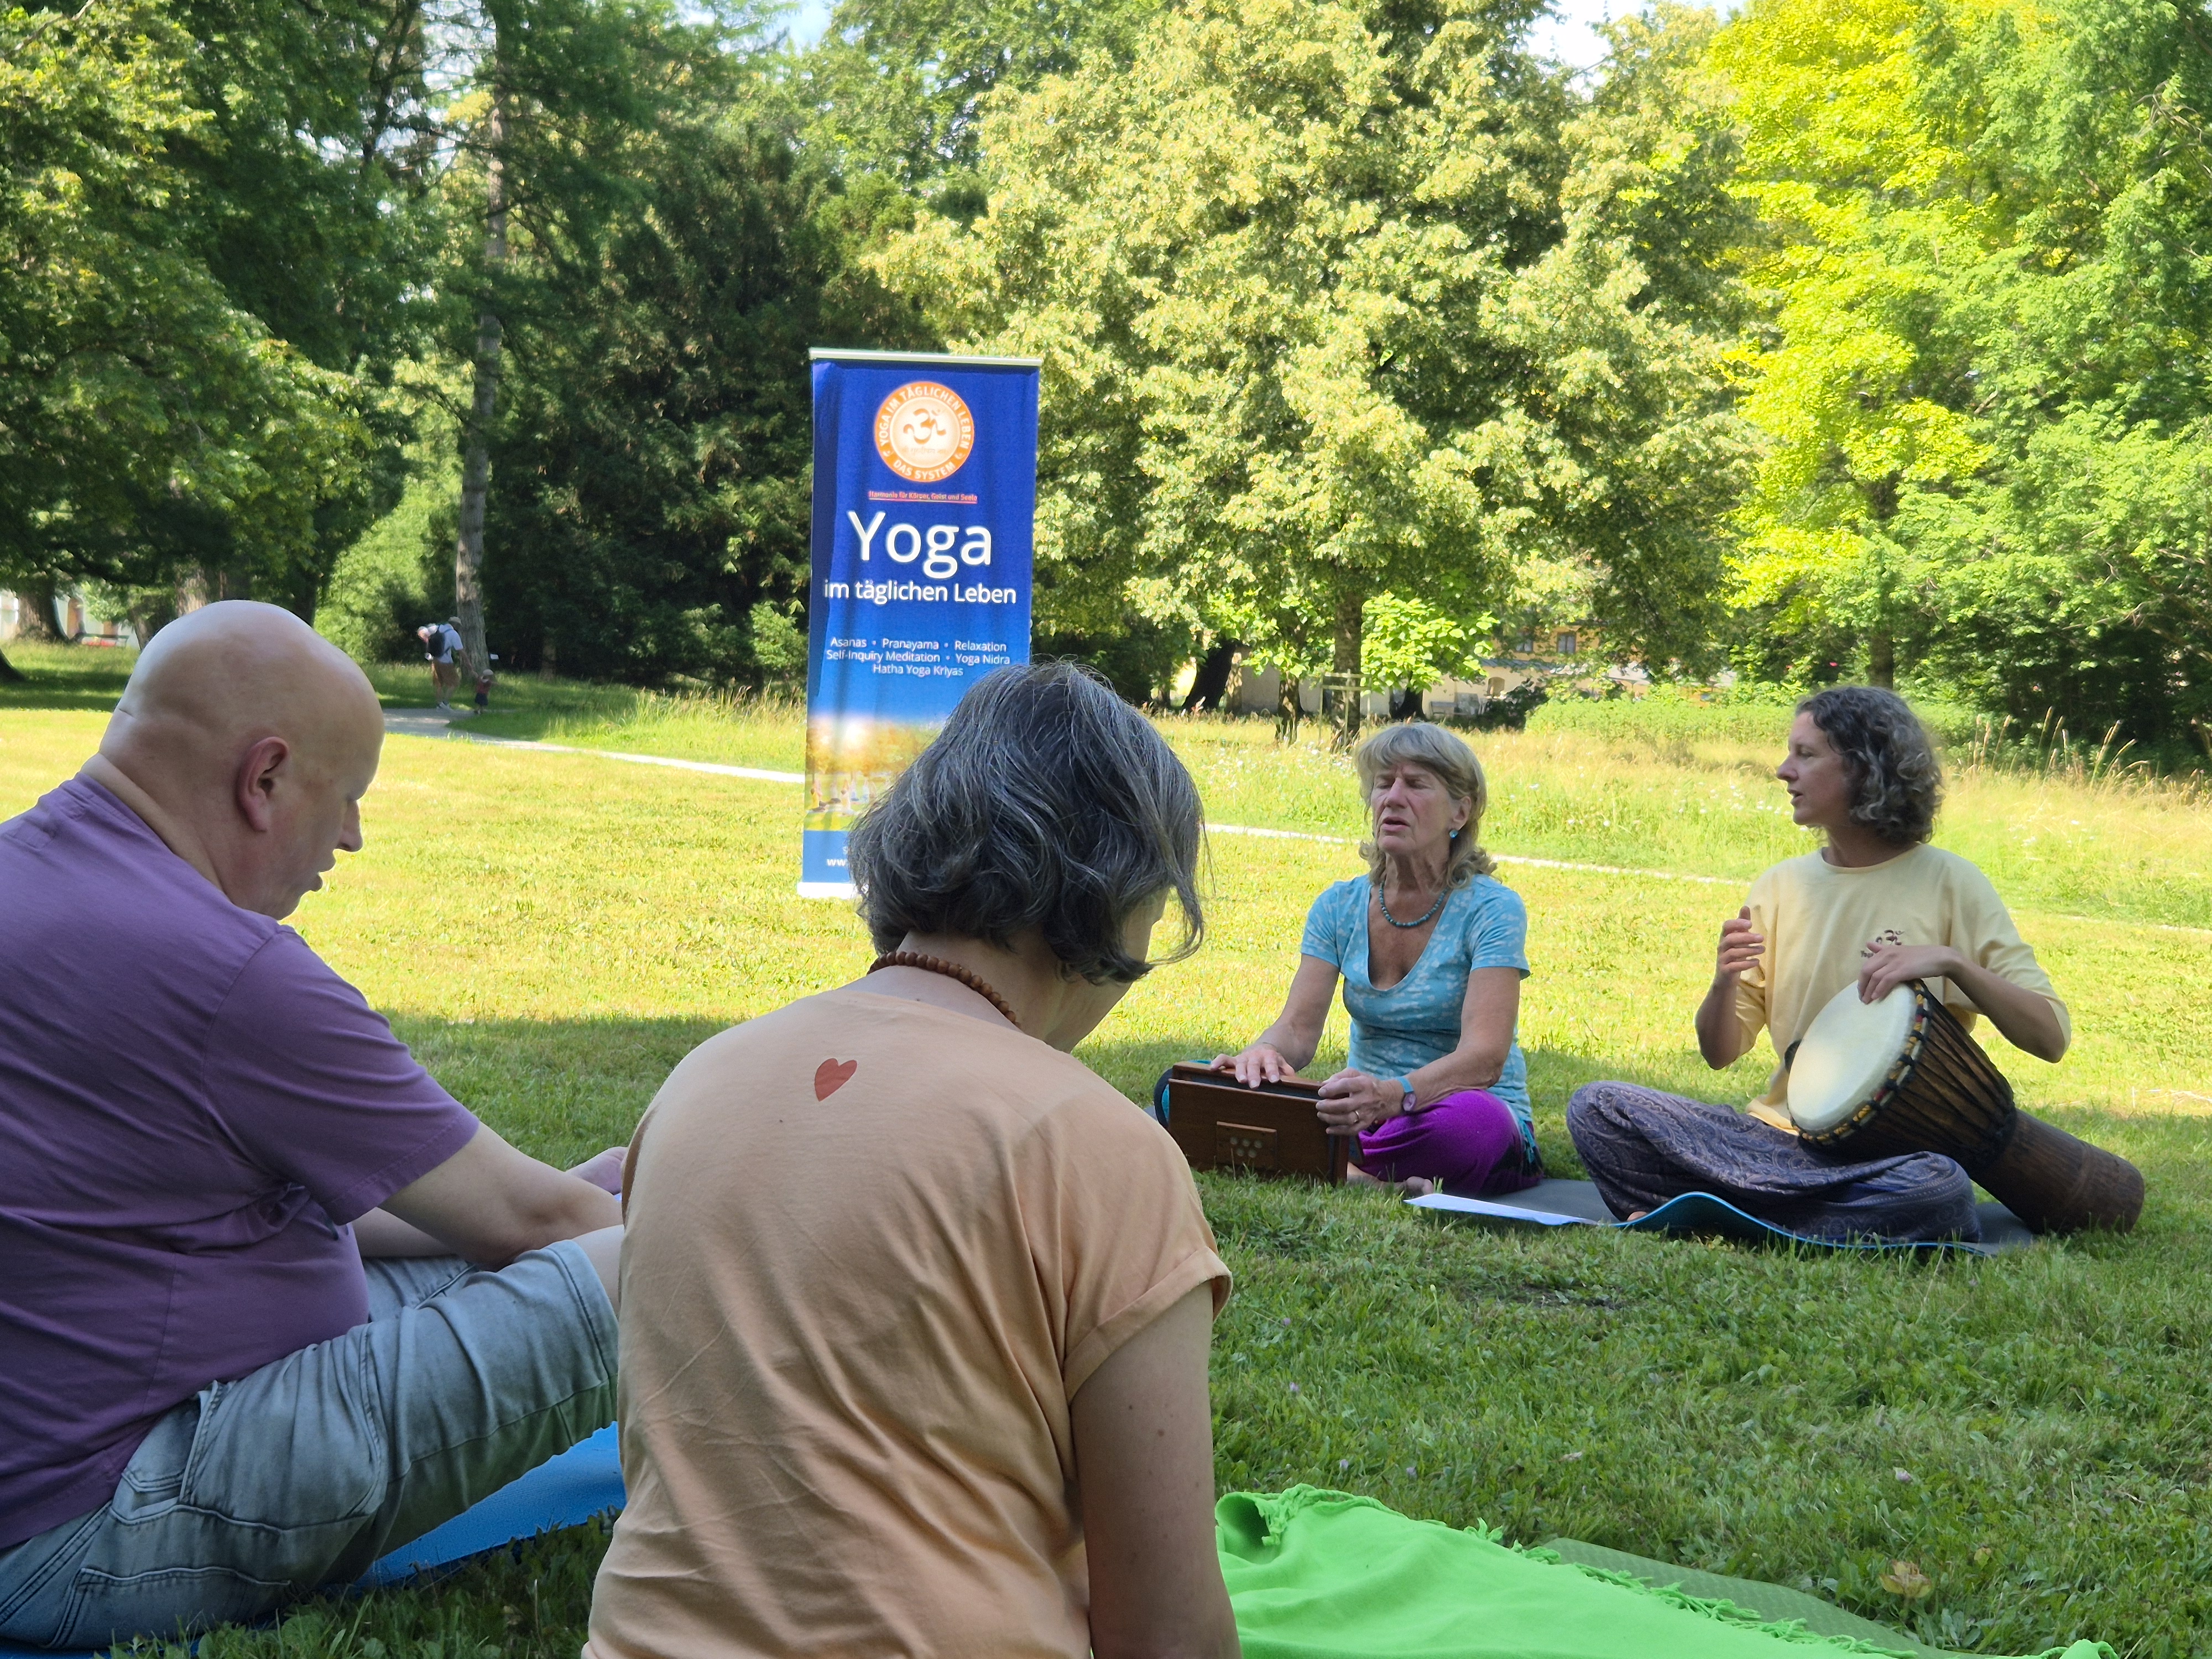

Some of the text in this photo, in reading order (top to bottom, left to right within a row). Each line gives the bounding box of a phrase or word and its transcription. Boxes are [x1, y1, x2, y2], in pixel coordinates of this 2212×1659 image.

[879, 386, 971, 449] YOGA IM TÄGLICHEN LEBEN
[893, 460, 956, 480] DAS SYSTEM
[846, 510, 992, 579] Yoga
[825, 580, 1016, 605] im täglichen Leben
[831, 637, 1007, 652] Asanas Pranayama Relaxation
[827, 650, 1010, 666] Self-Inquiry Meditation Yoga Nidra
[873, 664, 963, 678] Hatha Yoga Kriyas
